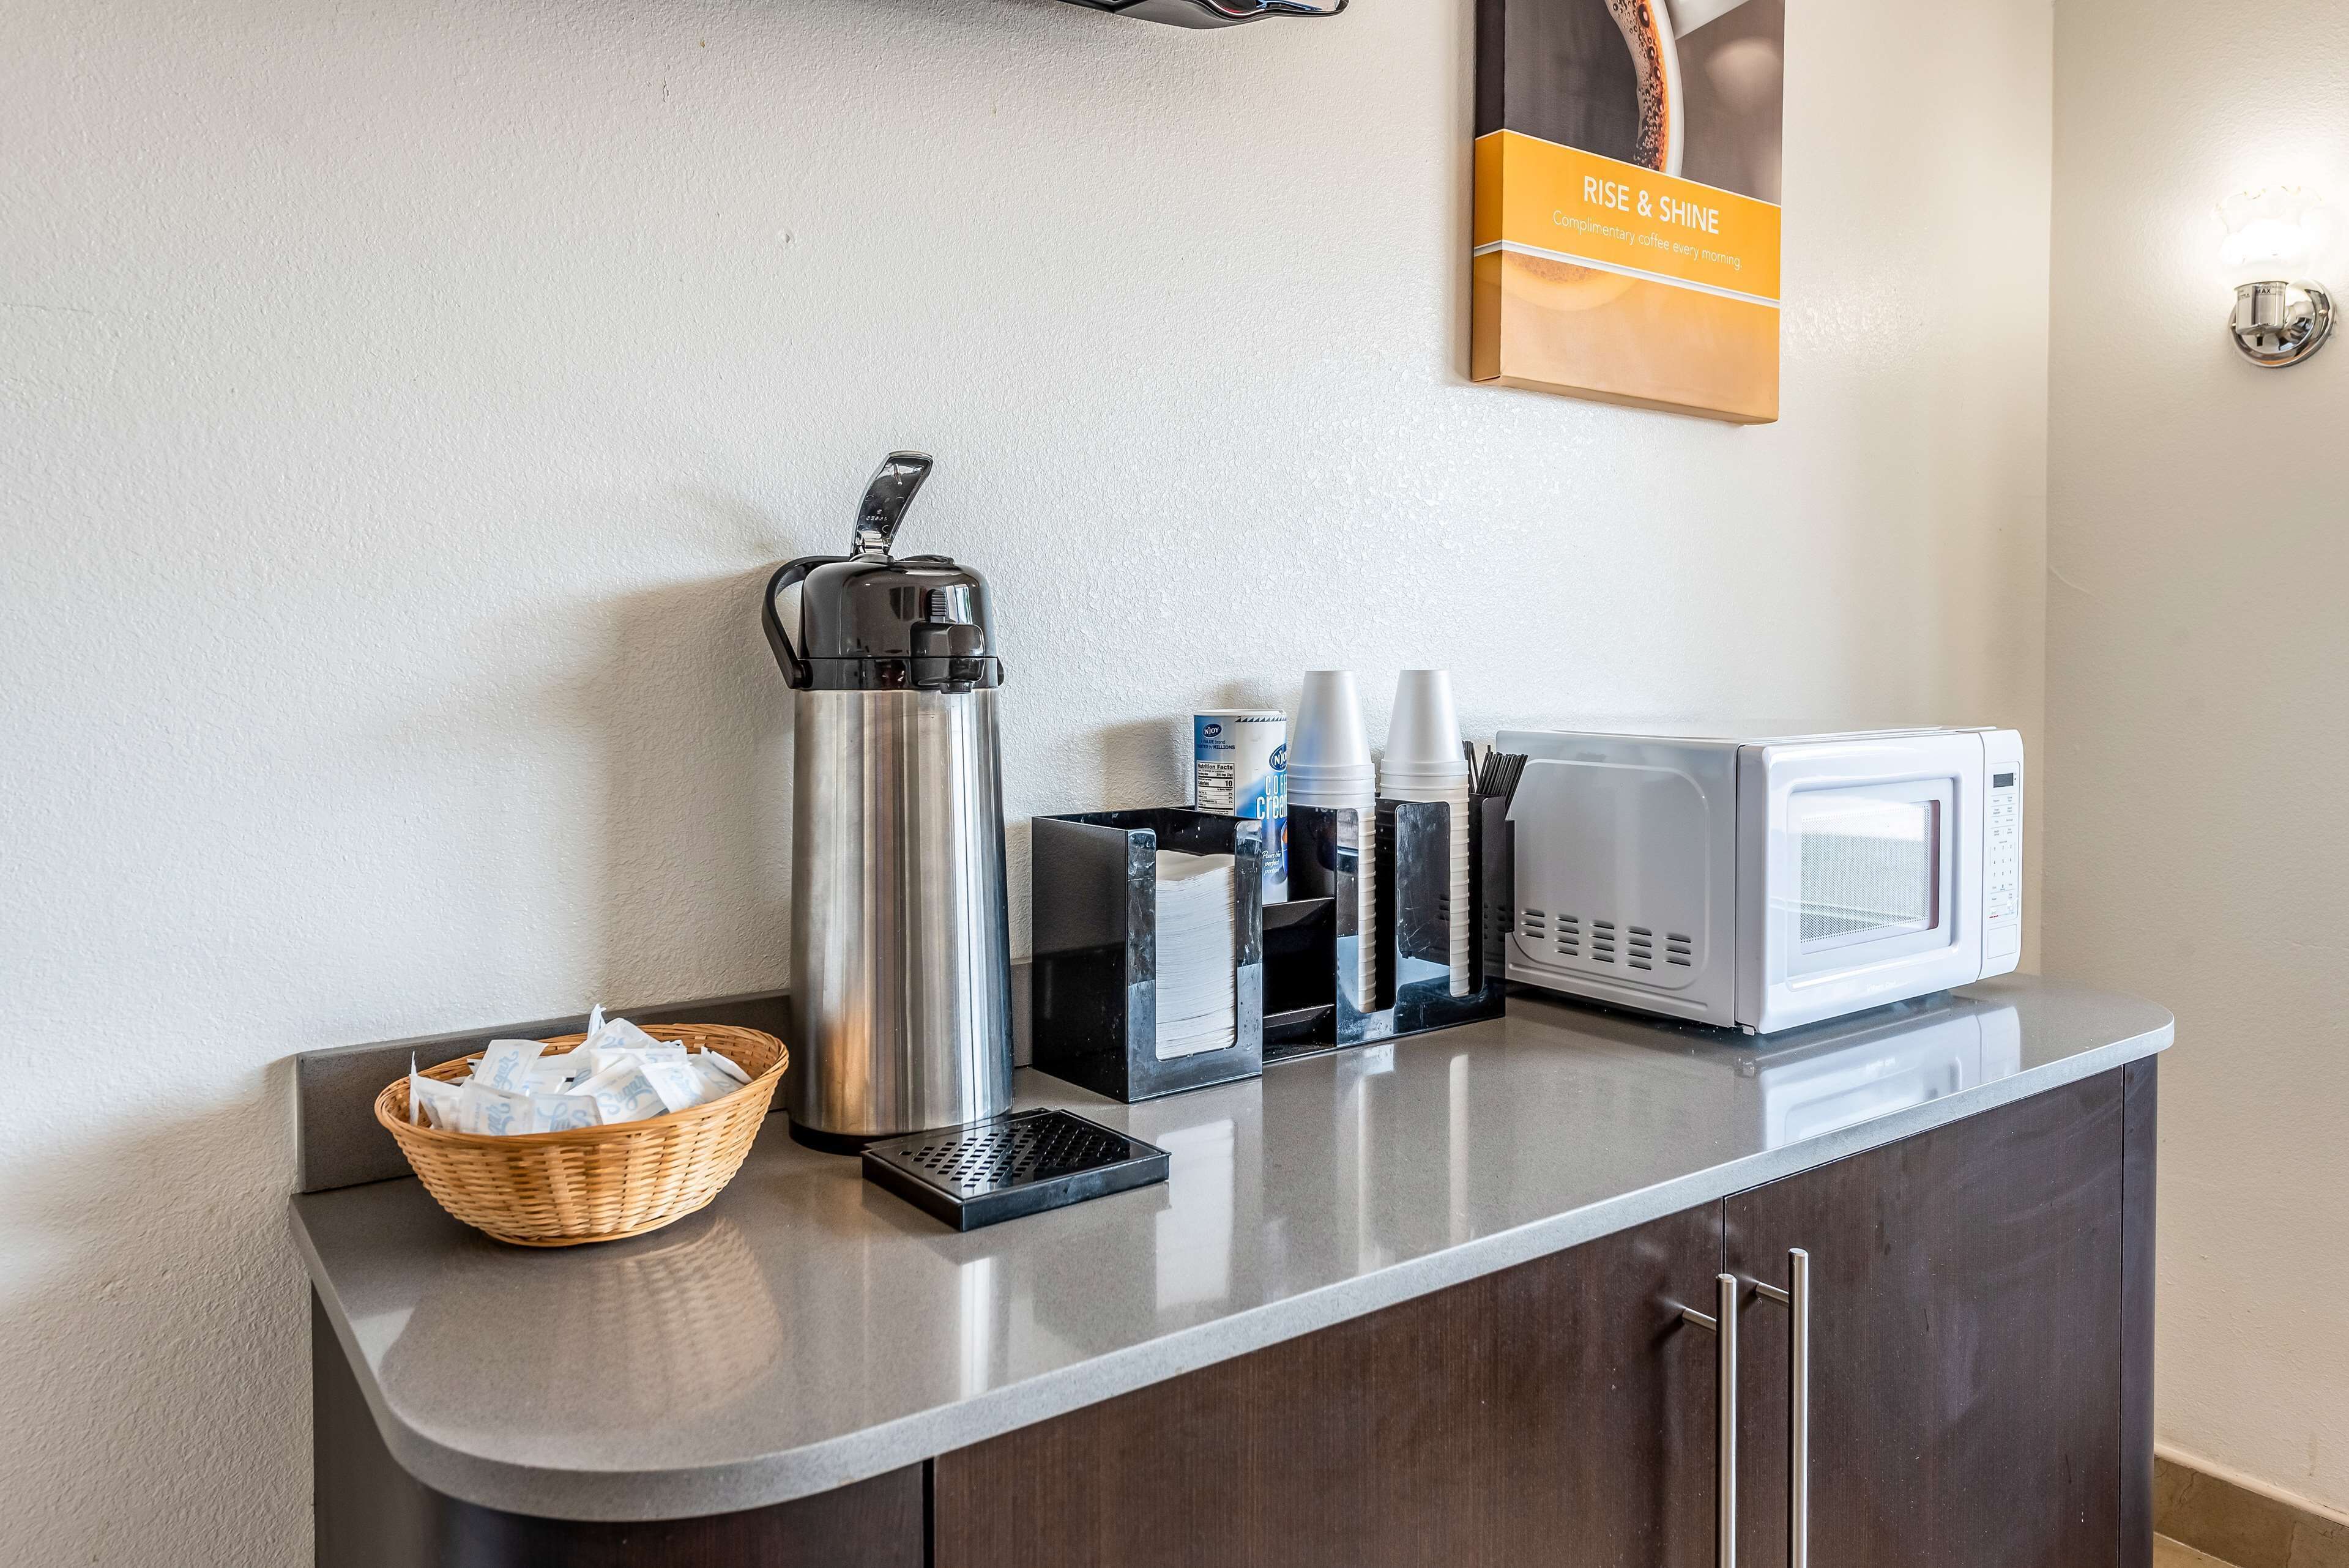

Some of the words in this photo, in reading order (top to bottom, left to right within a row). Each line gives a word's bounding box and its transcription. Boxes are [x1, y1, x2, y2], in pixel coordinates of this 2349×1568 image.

[1584, 176, 1629, 212] RISE
[1637, 190, 1652, 217] &
[1659, 195, 1719, 234] SHINE
[1553, 210, 1635, 245] Complimentary
[1638, 232, 1670, 250] coffee
[1673, 243, 1699, 261] every
[1702, 250, 1743, 270] morning.
[1265, 773, 1287, 795] COFF
[1262, 850, 1275, 859] Pours
[1264, 858, 1279, 868] perfect
[493, 1050, 519, 1090] ugar
